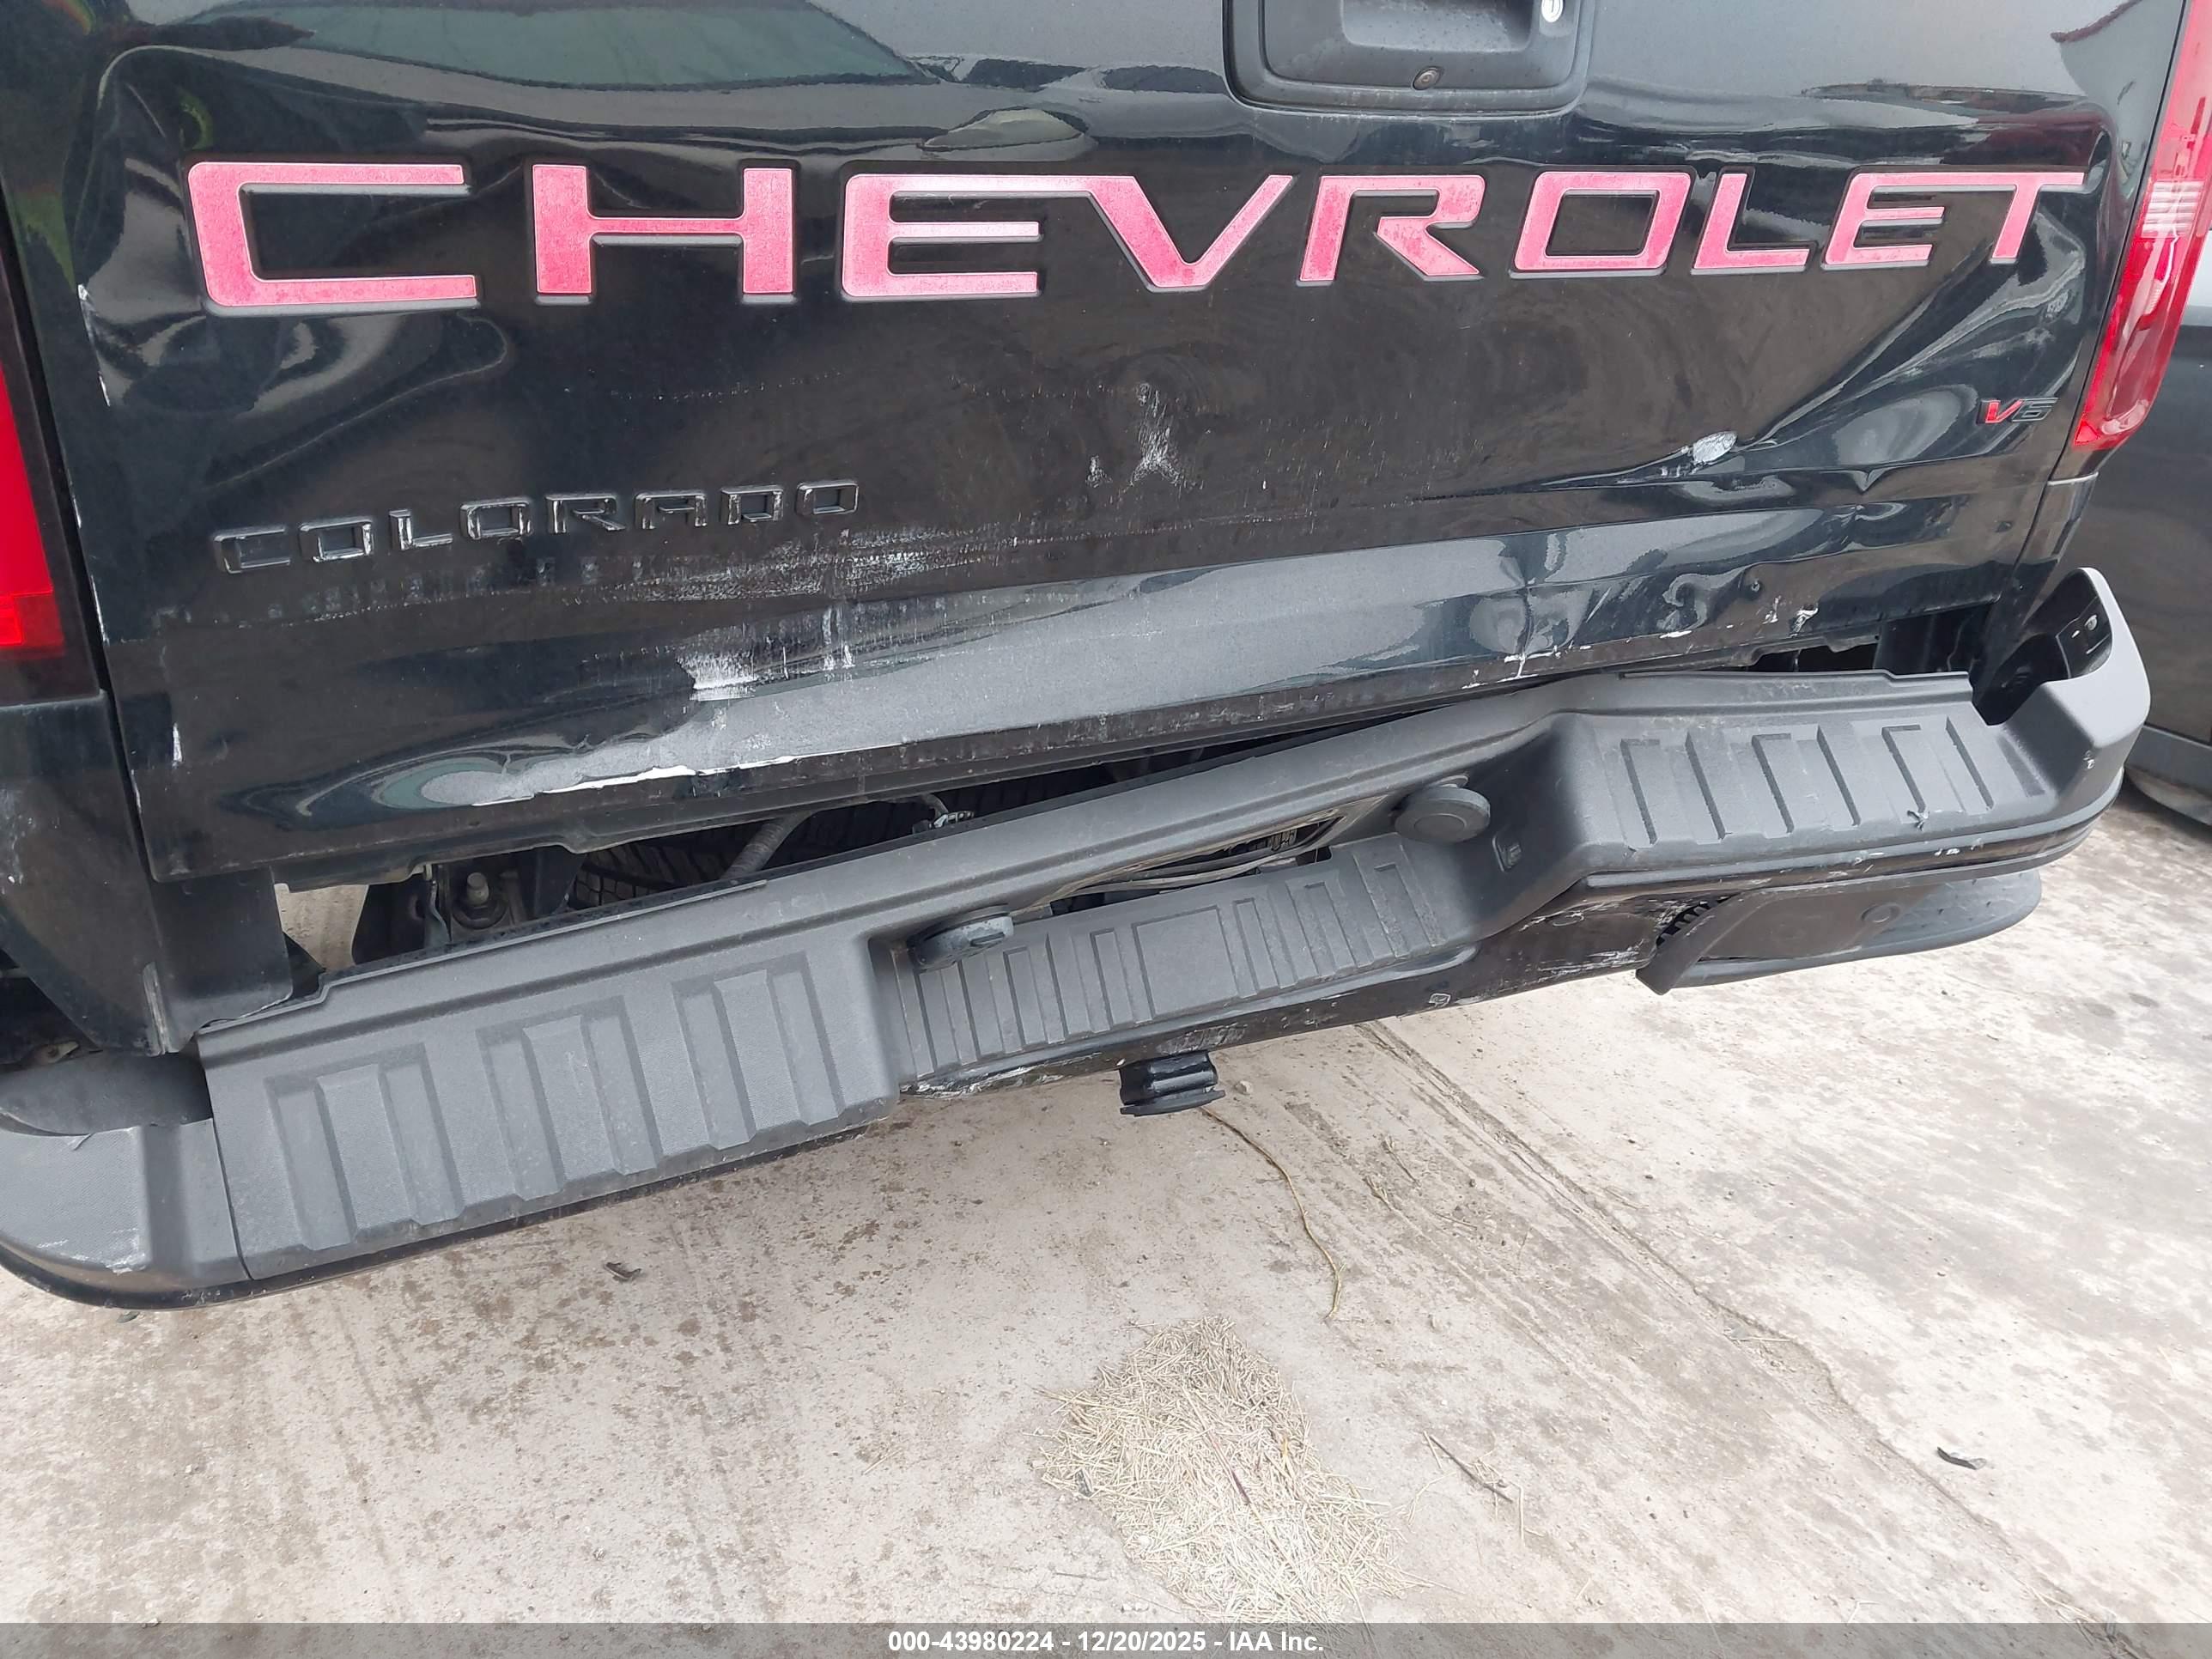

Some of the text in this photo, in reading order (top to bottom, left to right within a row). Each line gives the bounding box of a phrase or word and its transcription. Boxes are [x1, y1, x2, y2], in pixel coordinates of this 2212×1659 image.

[188, 161, 2087, 315] CHEVROLET
[1978, 398, 2058, 424] V6
[213, 480, 860, 574] COLORADO
